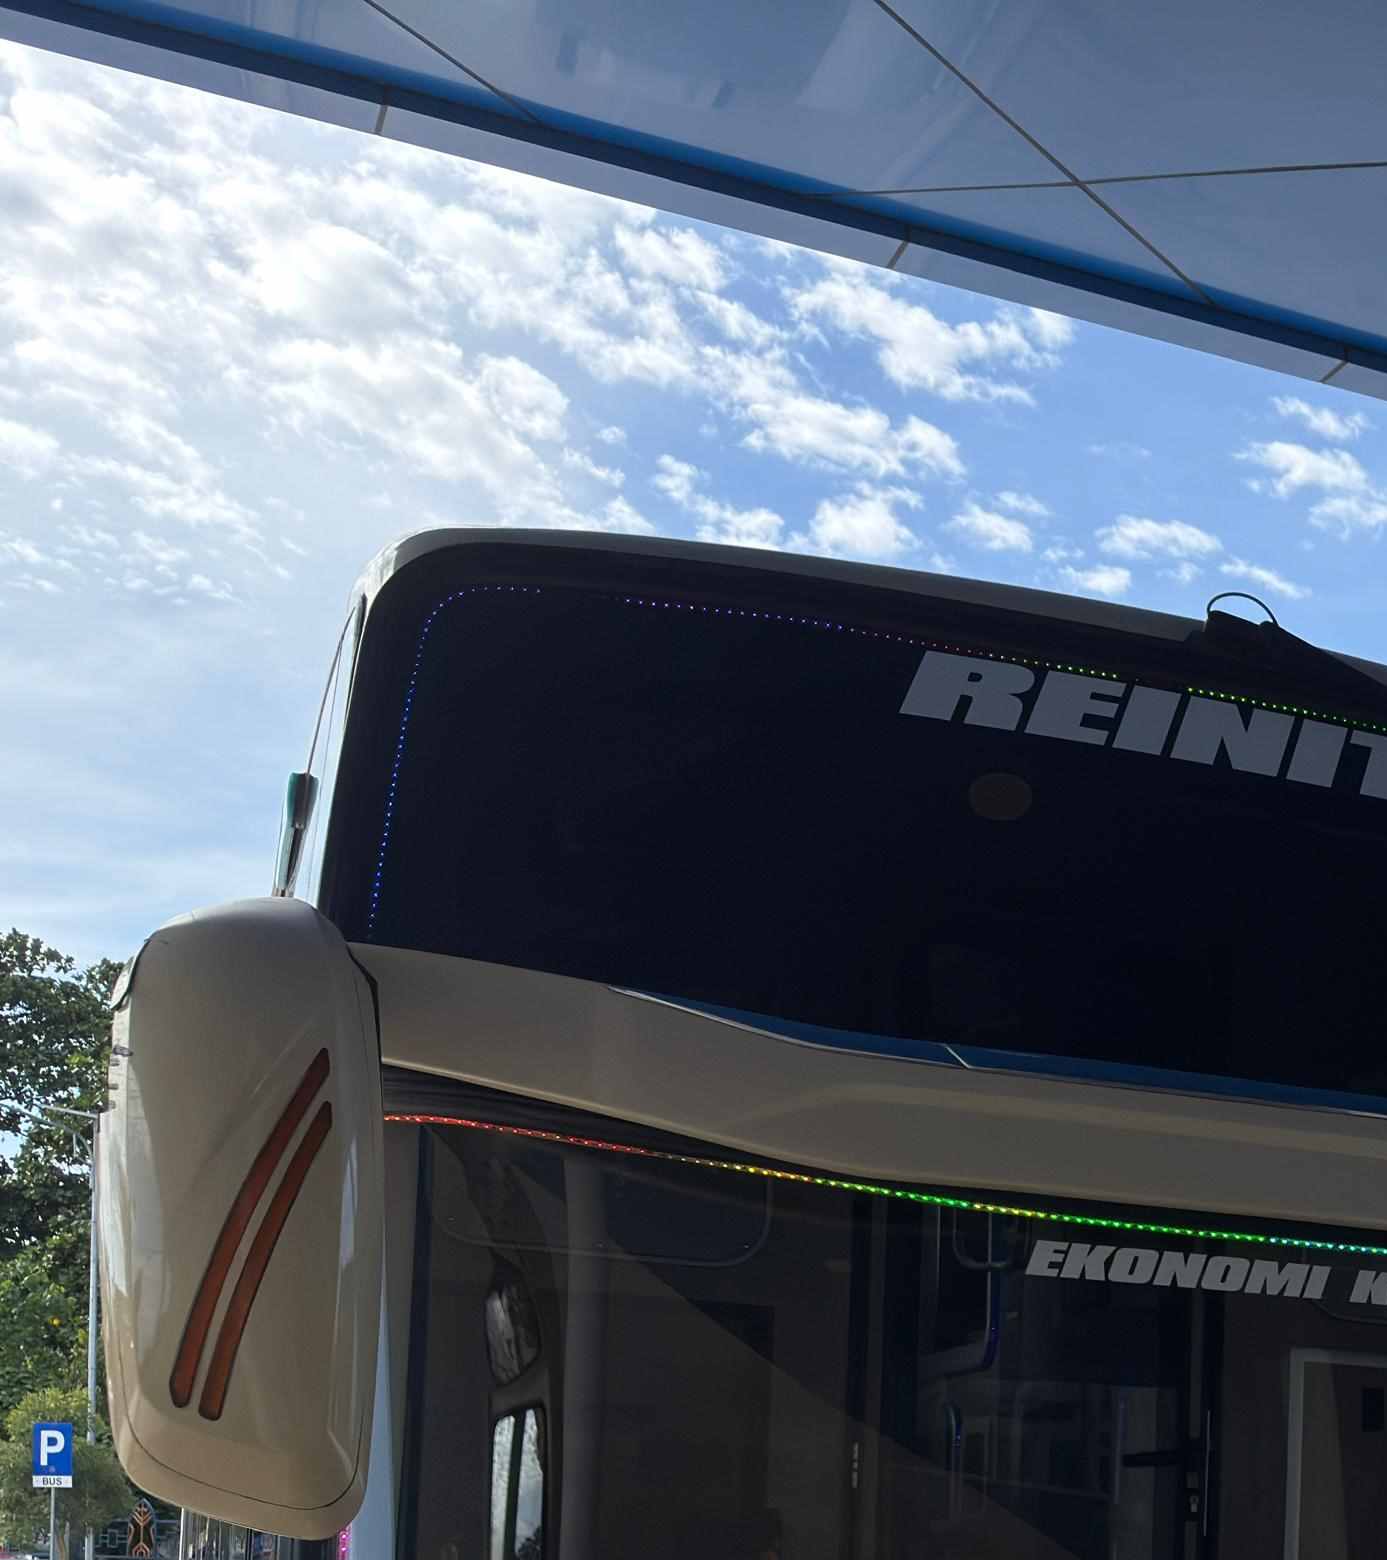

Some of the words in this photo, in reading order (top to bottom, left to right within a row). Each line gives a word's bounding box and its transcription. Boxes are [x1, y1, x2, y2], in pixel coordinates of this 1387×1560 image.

[1025, 1239, 1332, 1300] EKONOMI
[40, 1430, 65, 1466] P
[42, 1477, 63, 1486] BUS
